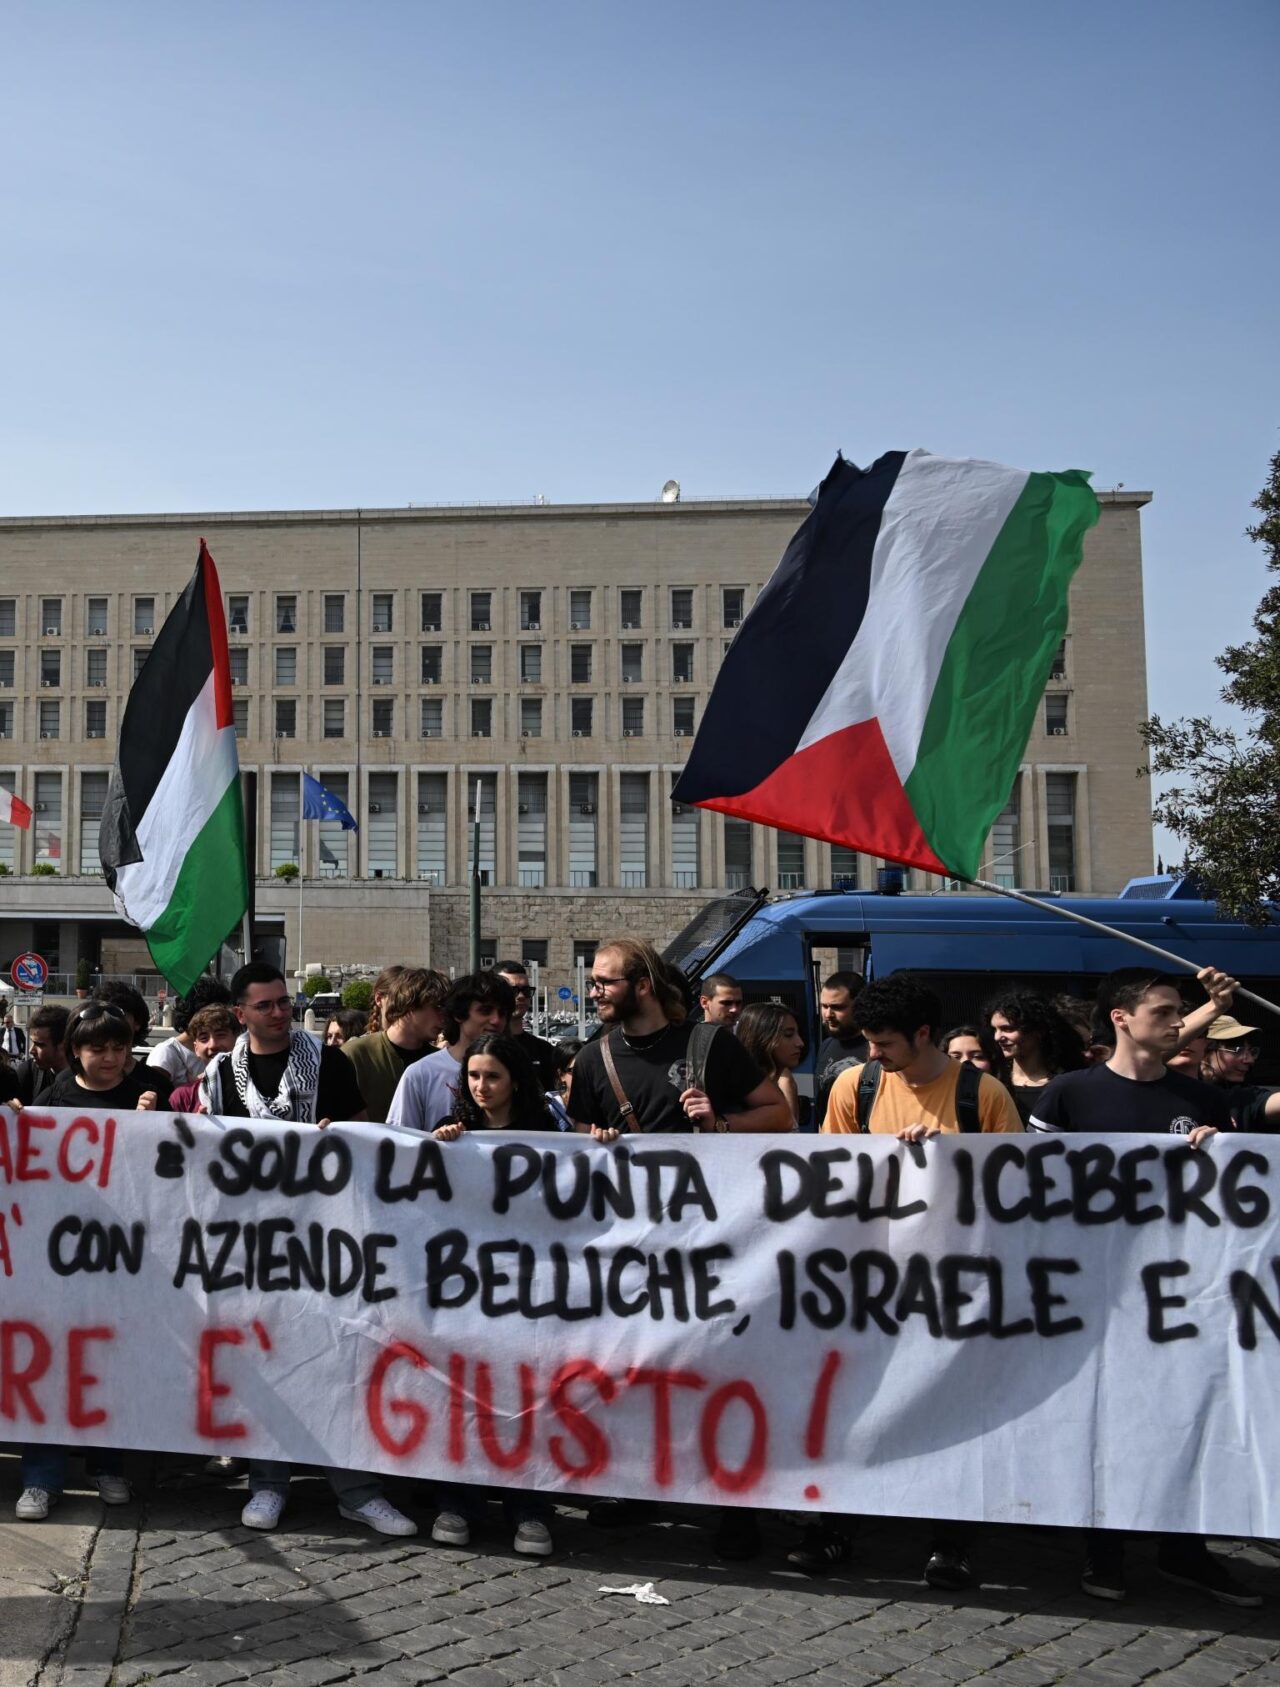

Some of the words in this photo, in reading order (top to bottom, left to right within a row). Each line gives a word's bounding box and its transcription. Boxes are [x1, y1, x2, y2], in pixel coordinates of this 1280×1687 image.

[207, 1127, 354, 1197] SOLO
[374, 1135, 454, 1204] LA
[492, 1142, 720, 1223] PUNTA
[47, 1213, 146, 1278] CON
[172, 1217, 398, 1303] AZIENDE
[776, 1247, 1085, 1340] ISRAELE
[1141, 1259, 1199, 1343] E
